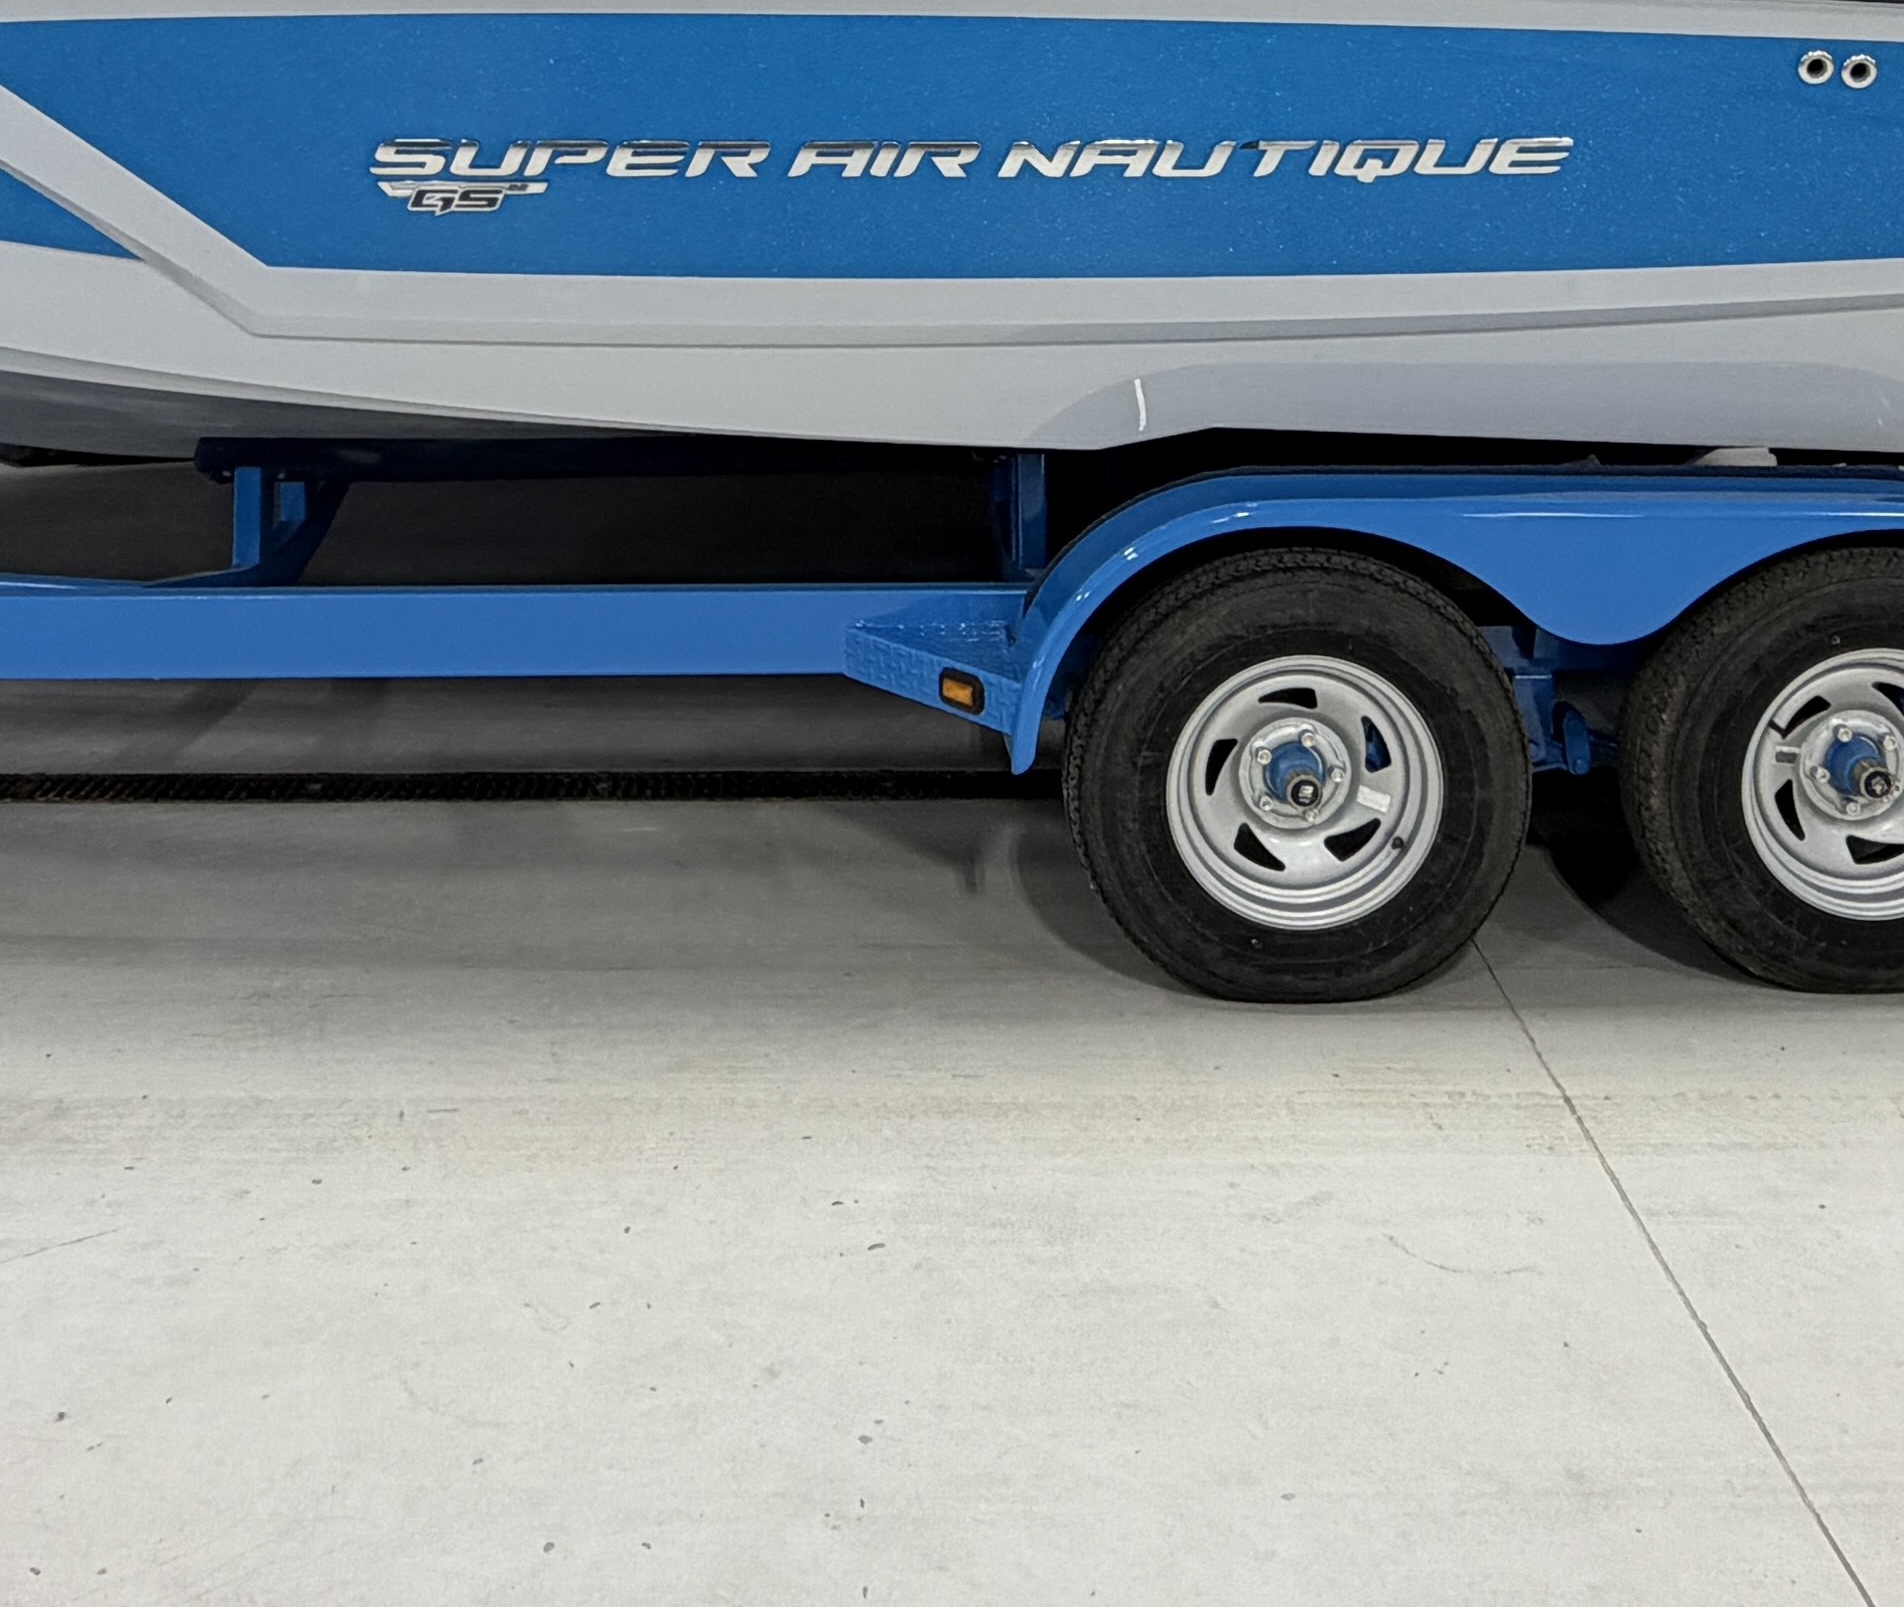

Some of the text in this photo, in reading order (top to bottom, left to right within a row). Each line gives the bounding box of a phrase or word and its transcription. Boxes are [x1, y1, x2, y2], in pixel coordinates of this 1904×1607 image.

[369, 137, 1575, 183] SUPER AIR NAUTIQUE
[408, 187, 505, 216] GS
